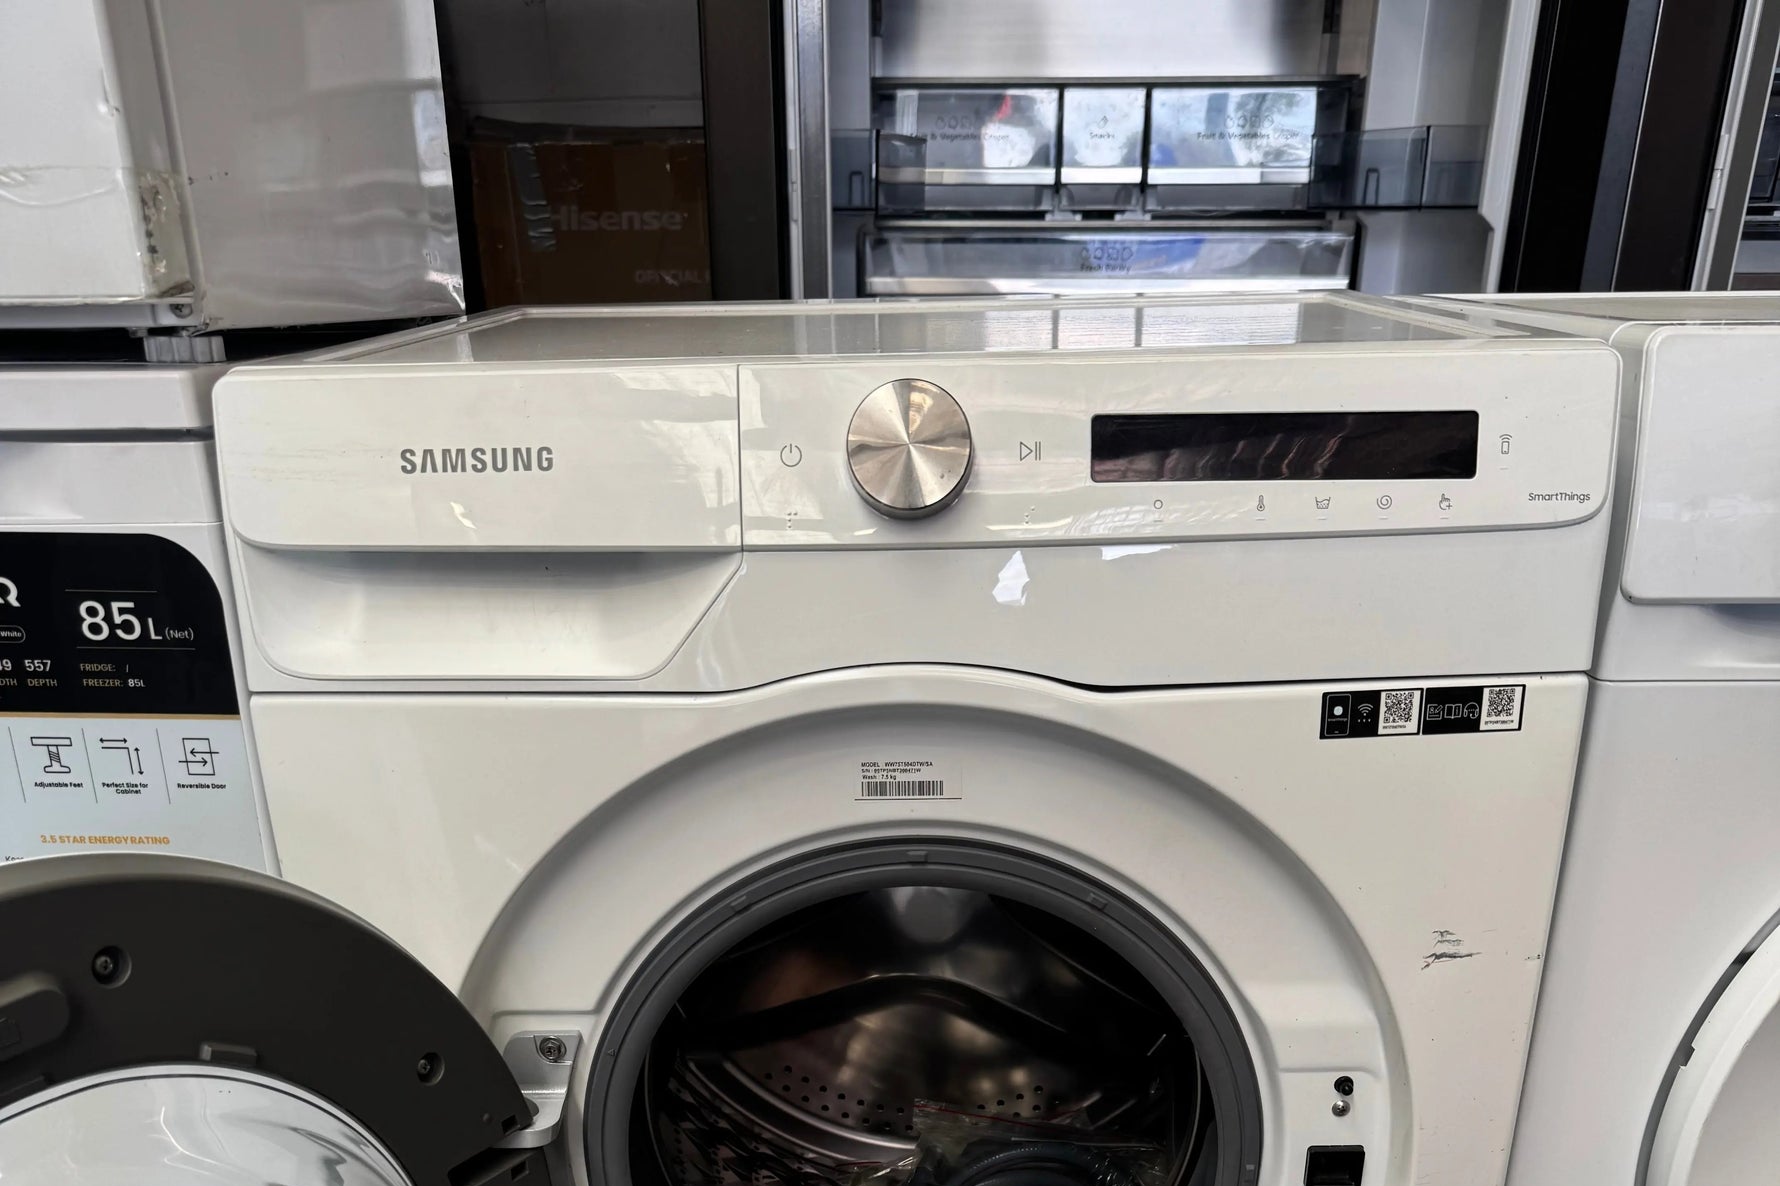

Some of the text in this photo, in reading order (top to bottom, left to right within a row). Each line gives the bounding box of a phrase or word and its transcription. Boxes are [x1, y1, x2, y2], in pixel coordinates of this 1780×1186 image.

[400, 446, 554, 474] SAMSUNG
[1528, 491, 1591, 504] SmartThings
[24, 659, 51, 671] 557
[80, 663, 116, 672] FRIDGE:
[28, 678, 58, 687] DEPTH
[83, 678, 146, 687] FREEZER: 85L
[34, 781, 68, 790] Adjustable
[102, 781, 125, 789] Perfect
[177, 782, 210, 790] Reversible
[40, 834, 170, 845] 3.5 STAR ENERGY RATING
